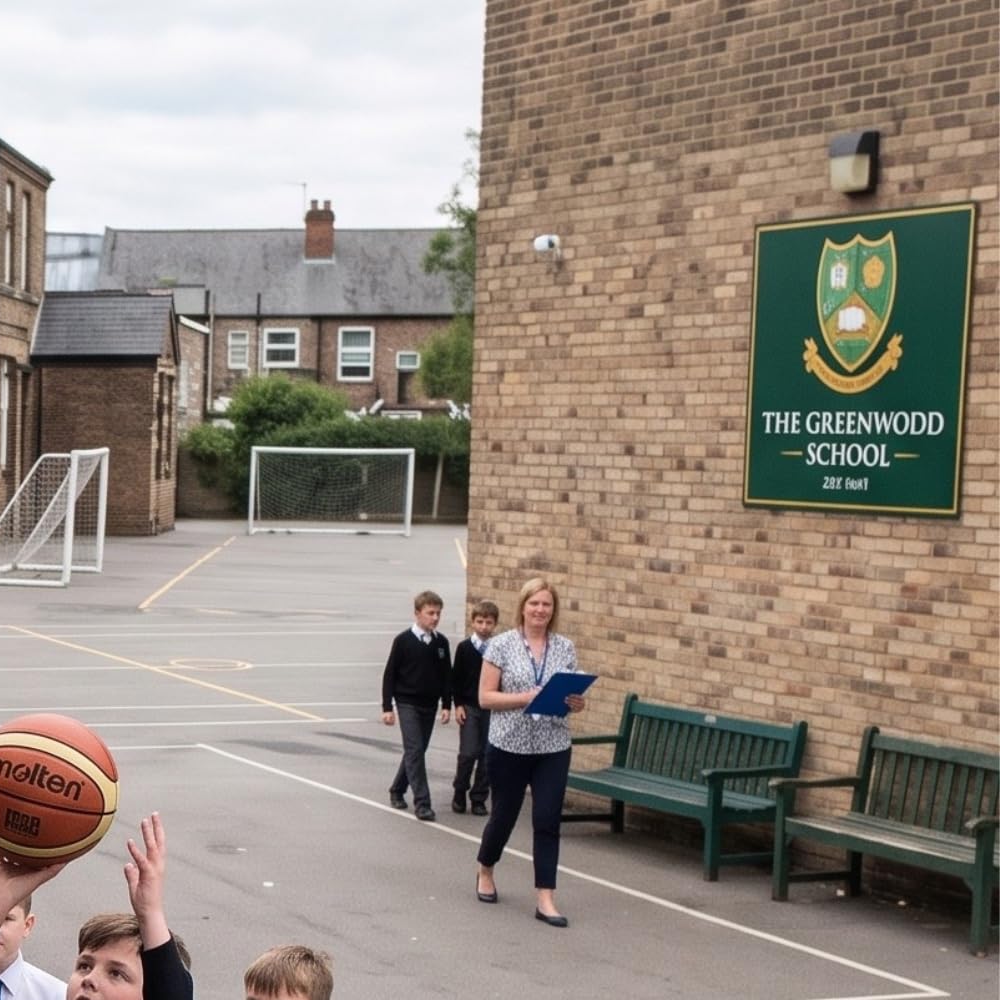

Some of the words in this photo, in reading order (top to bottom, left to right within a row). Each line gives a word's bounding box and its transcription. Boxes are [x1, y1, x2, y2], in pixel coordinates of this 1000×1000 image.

[762, 411, 801, 434] THE
[805, 411, 945, 435] GREENWODD
[806, 443, 890, 467] SCHOOL
